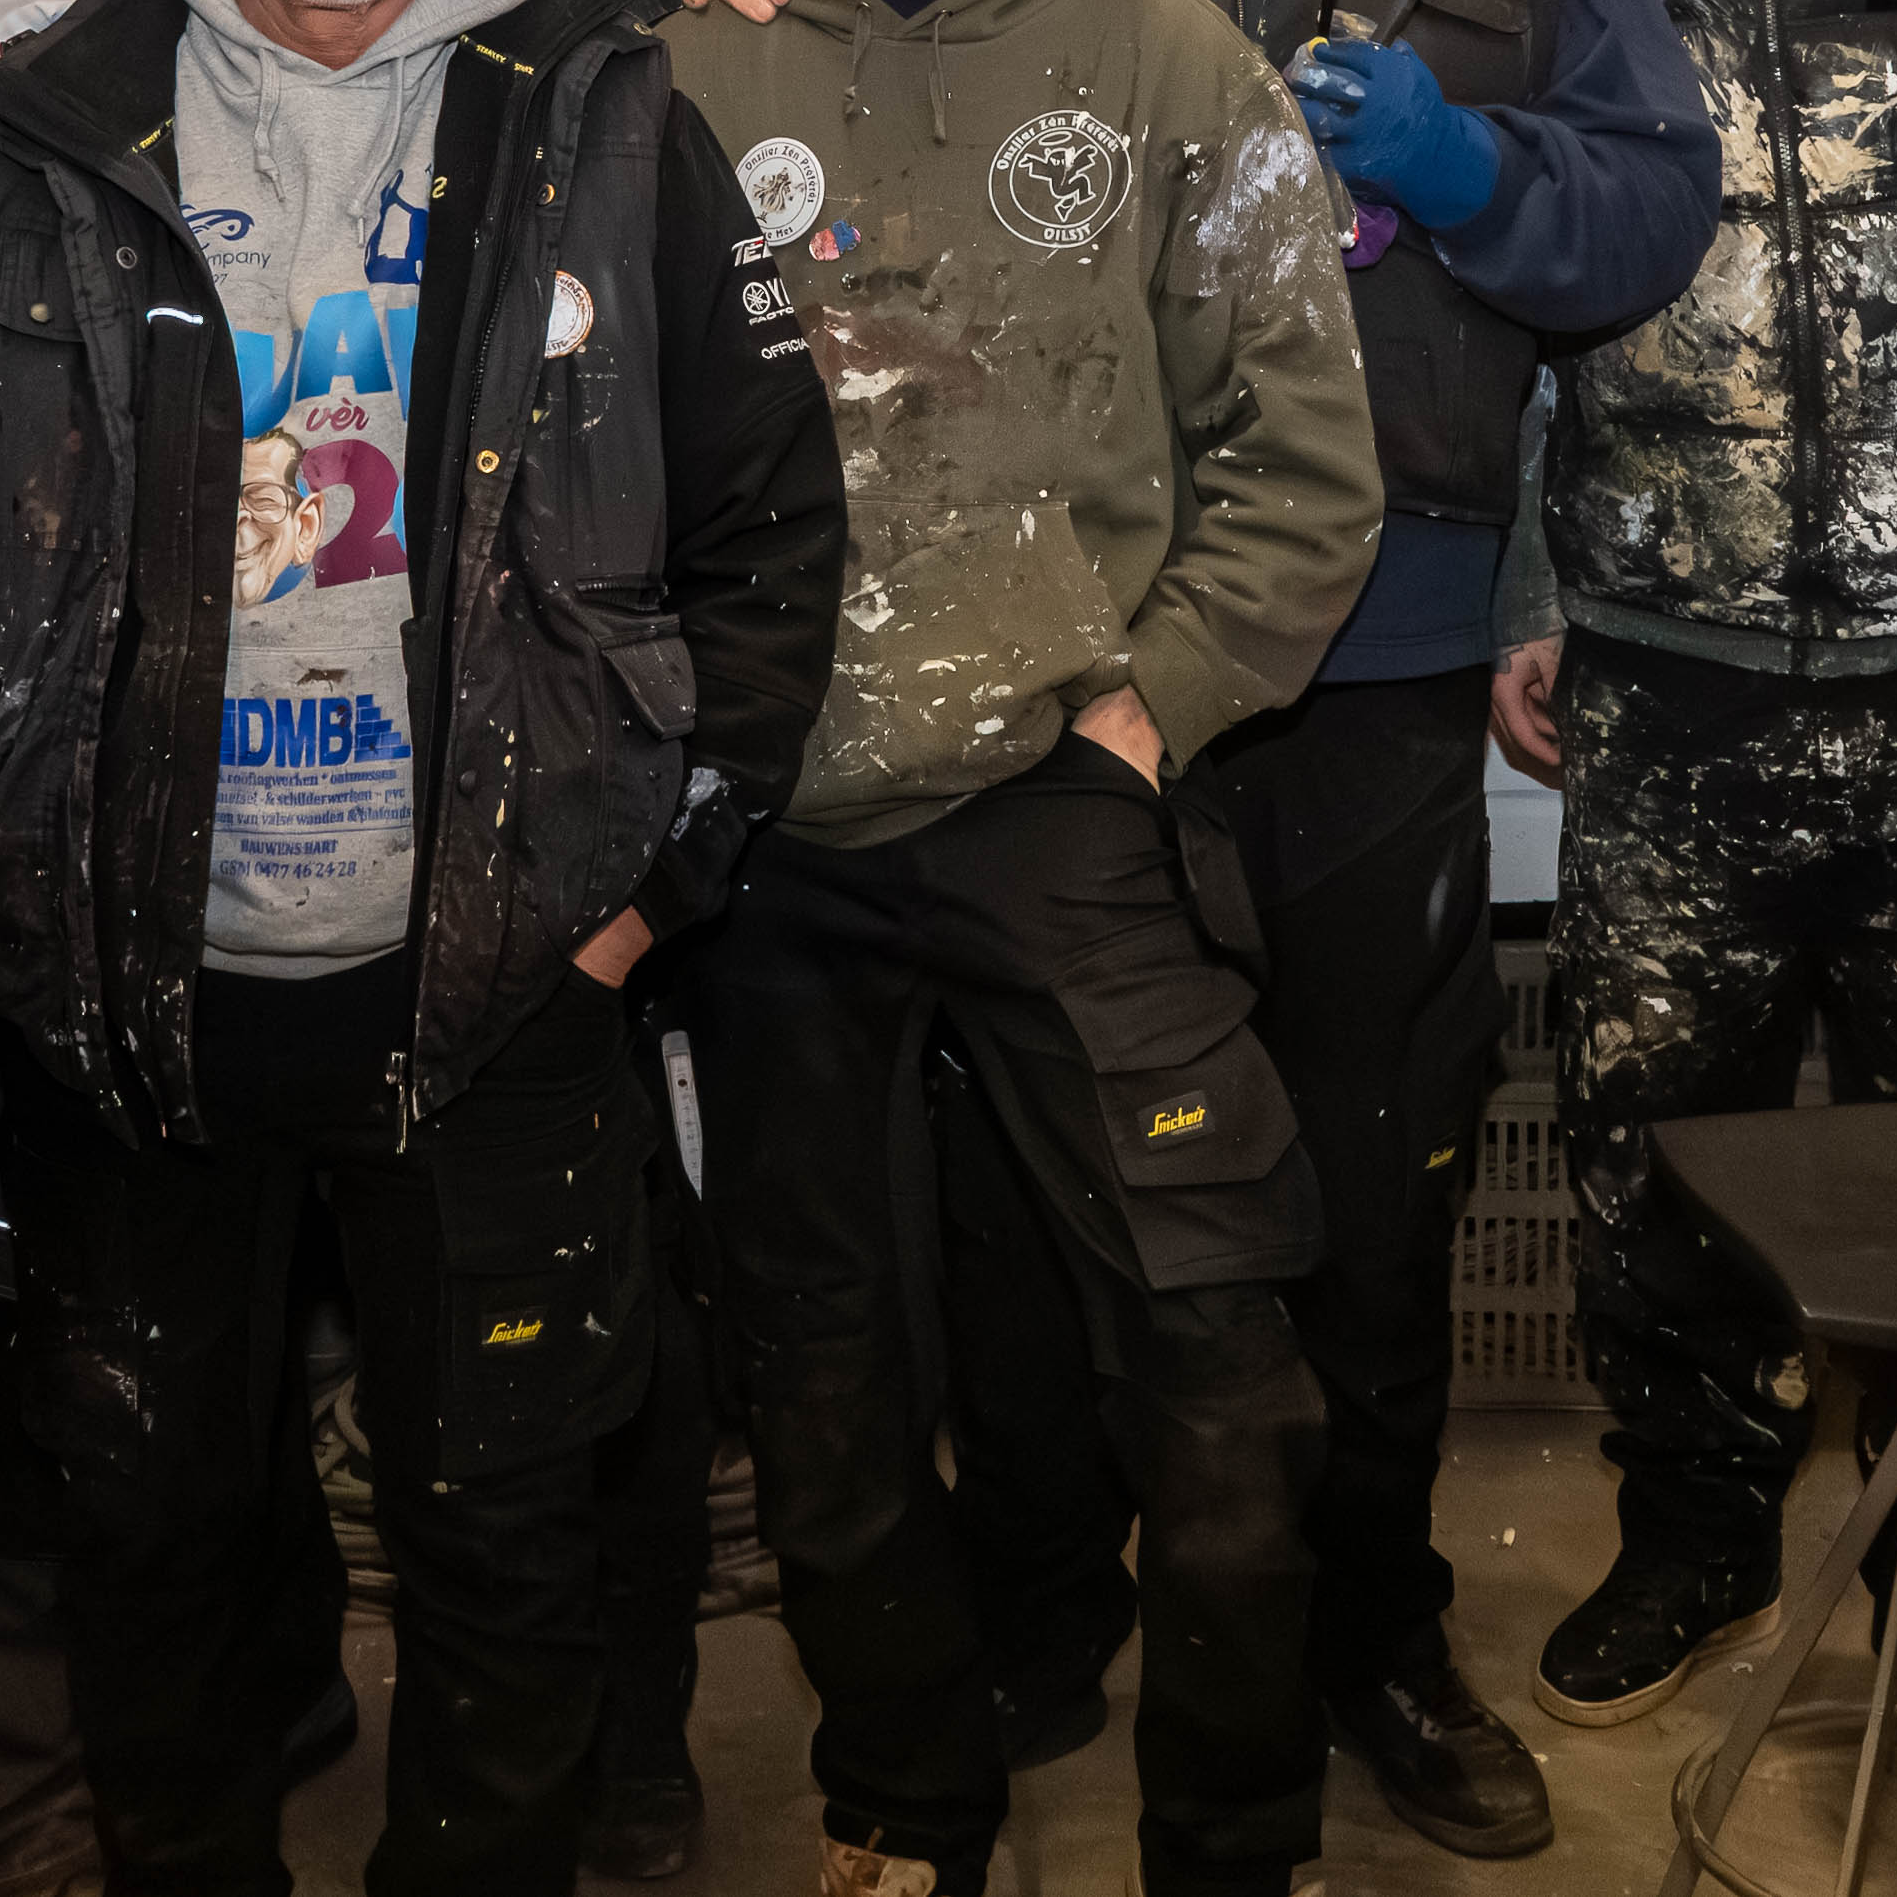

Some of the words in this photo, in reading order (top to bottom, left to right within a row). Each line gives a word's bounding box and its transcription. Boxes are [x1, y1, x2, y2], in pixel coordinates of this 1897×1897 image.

[206, 250, 272, 270] mpany
[293, 860, 312, 879] 46
[315, 861, 336, 878] 24
